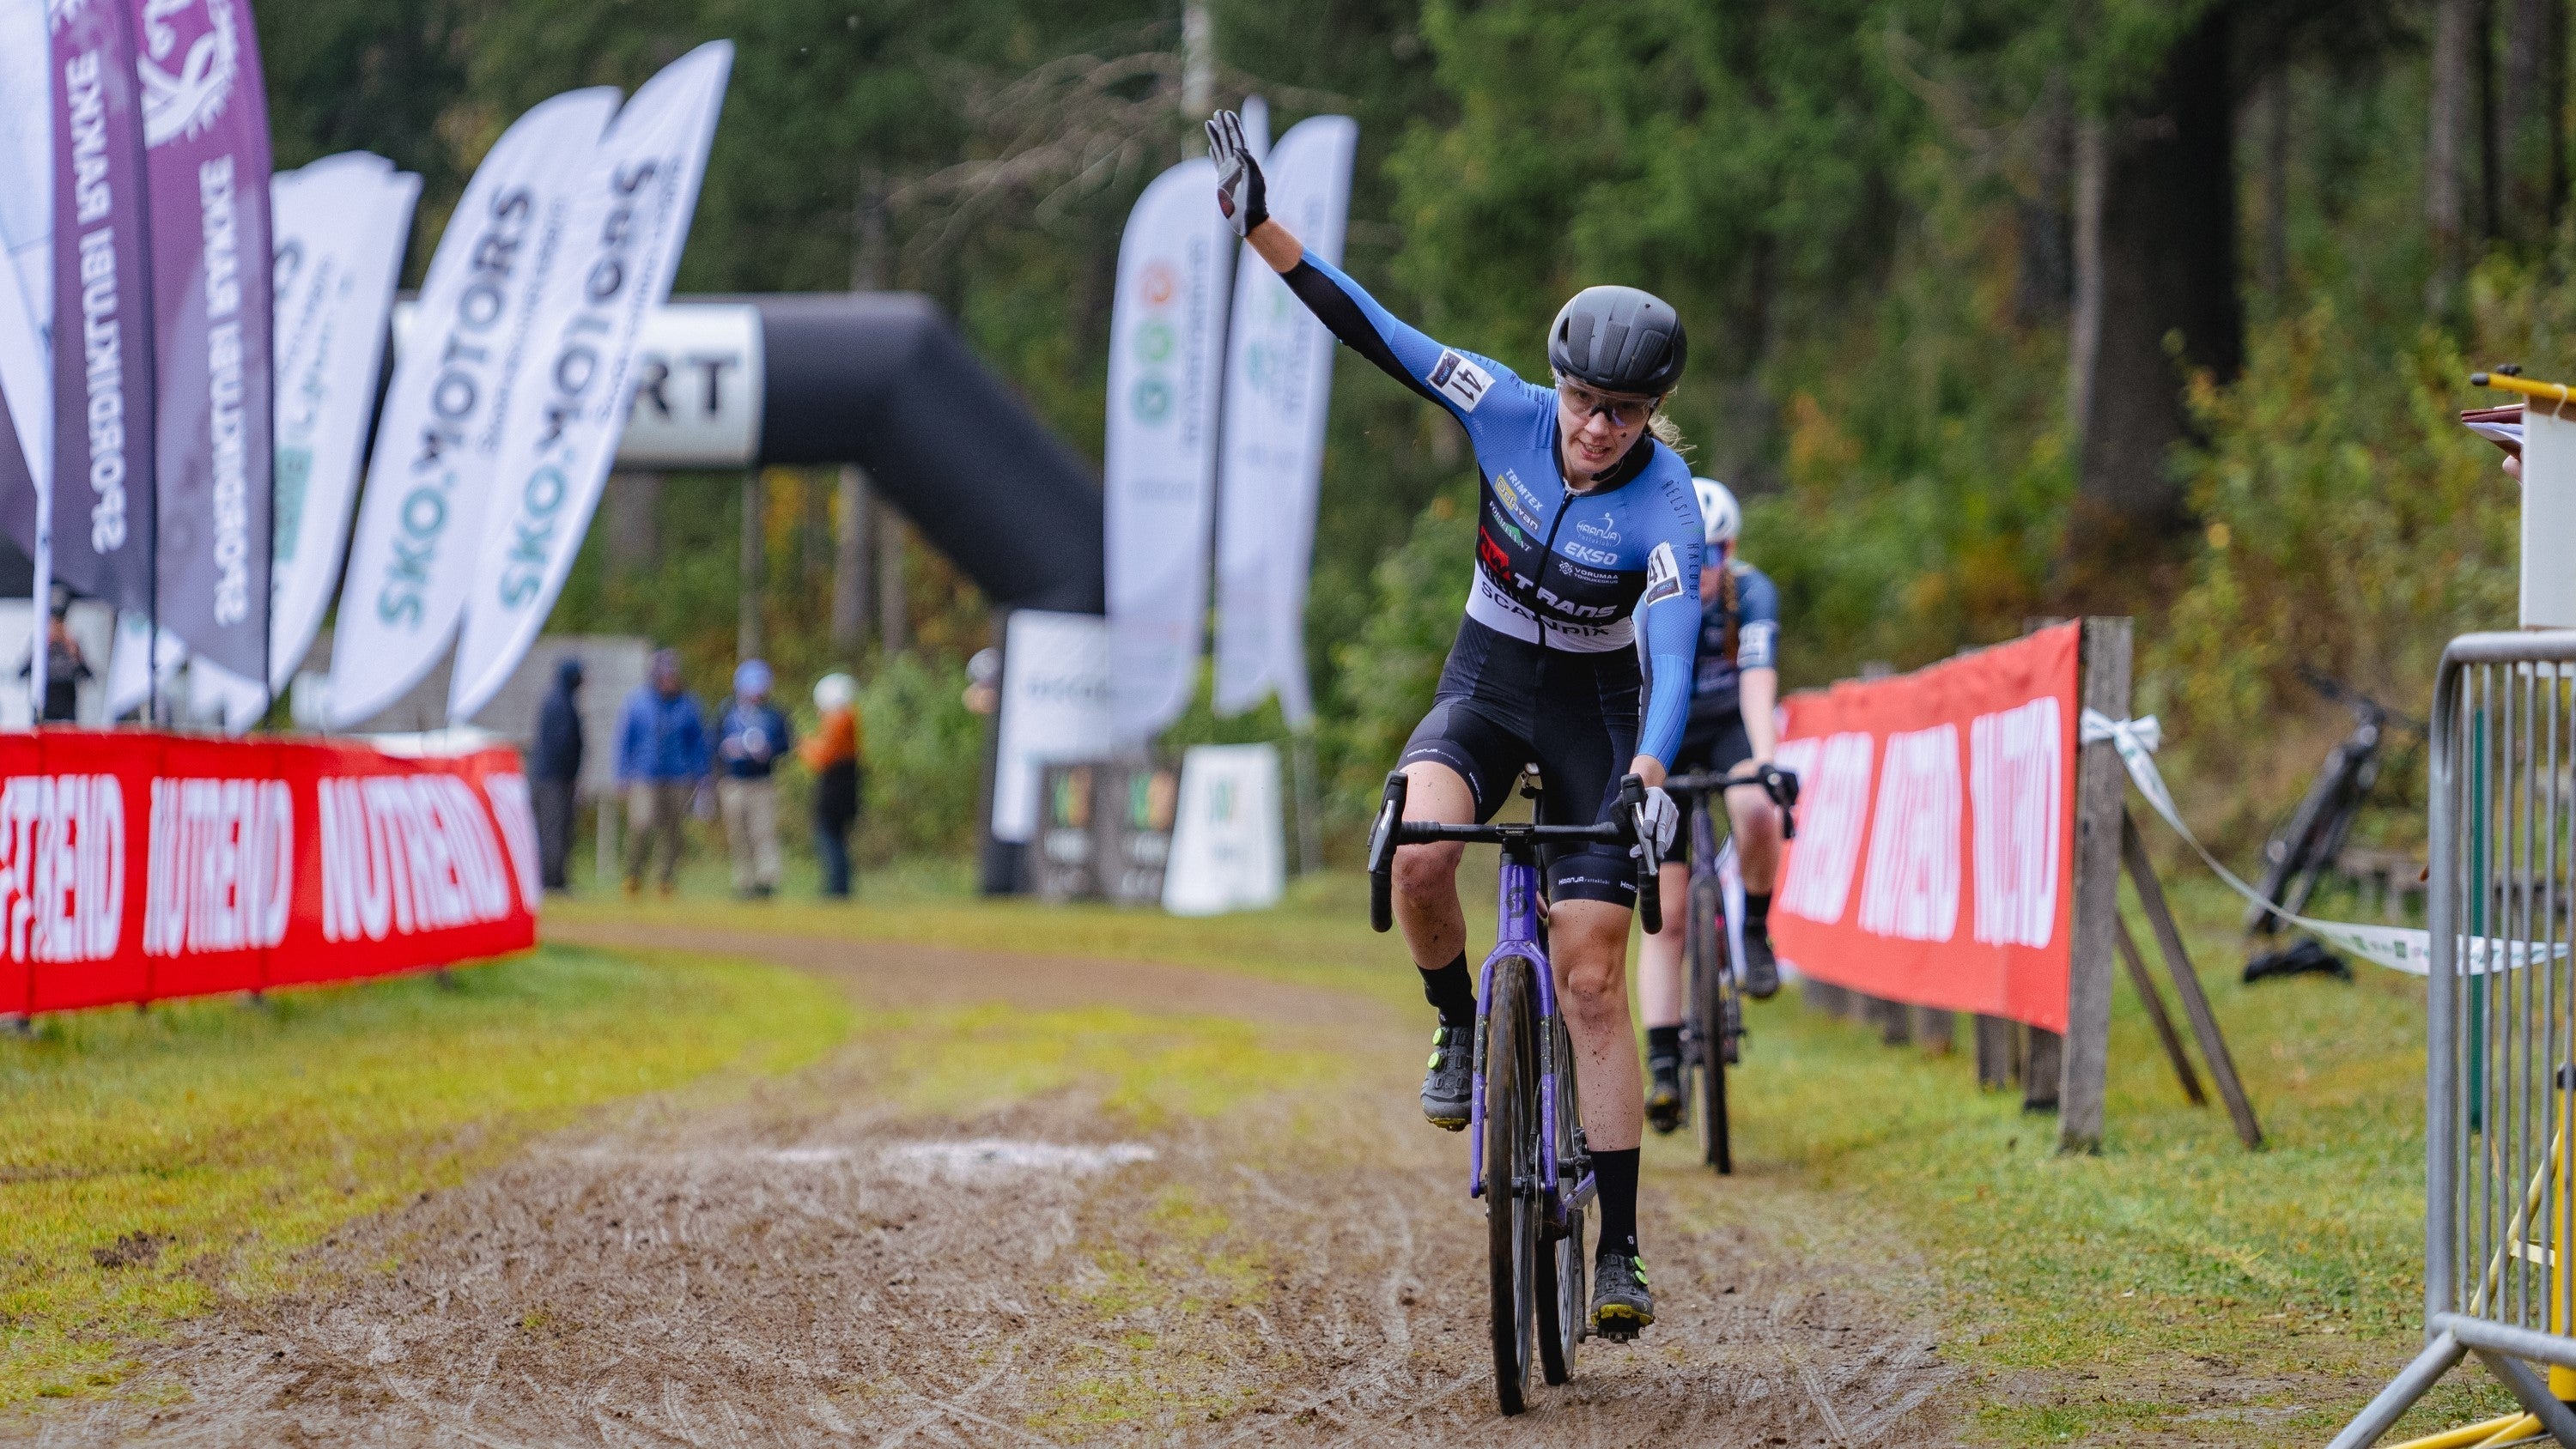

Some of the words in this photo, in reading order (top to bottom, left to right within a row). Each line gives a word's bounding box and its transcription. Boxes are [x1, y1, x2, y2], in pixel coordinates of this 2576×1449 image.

[1450, 368, 1483, 403] 41
[1497, 478, 1538, 530] Delavan
[1505, 468, 1543, 512] TRIMTEX
[1564, 542, 1618, 565] EKSO
[1648, 549, 1668, 584] 41
[1514, 573, 1618, 618] TRANS
